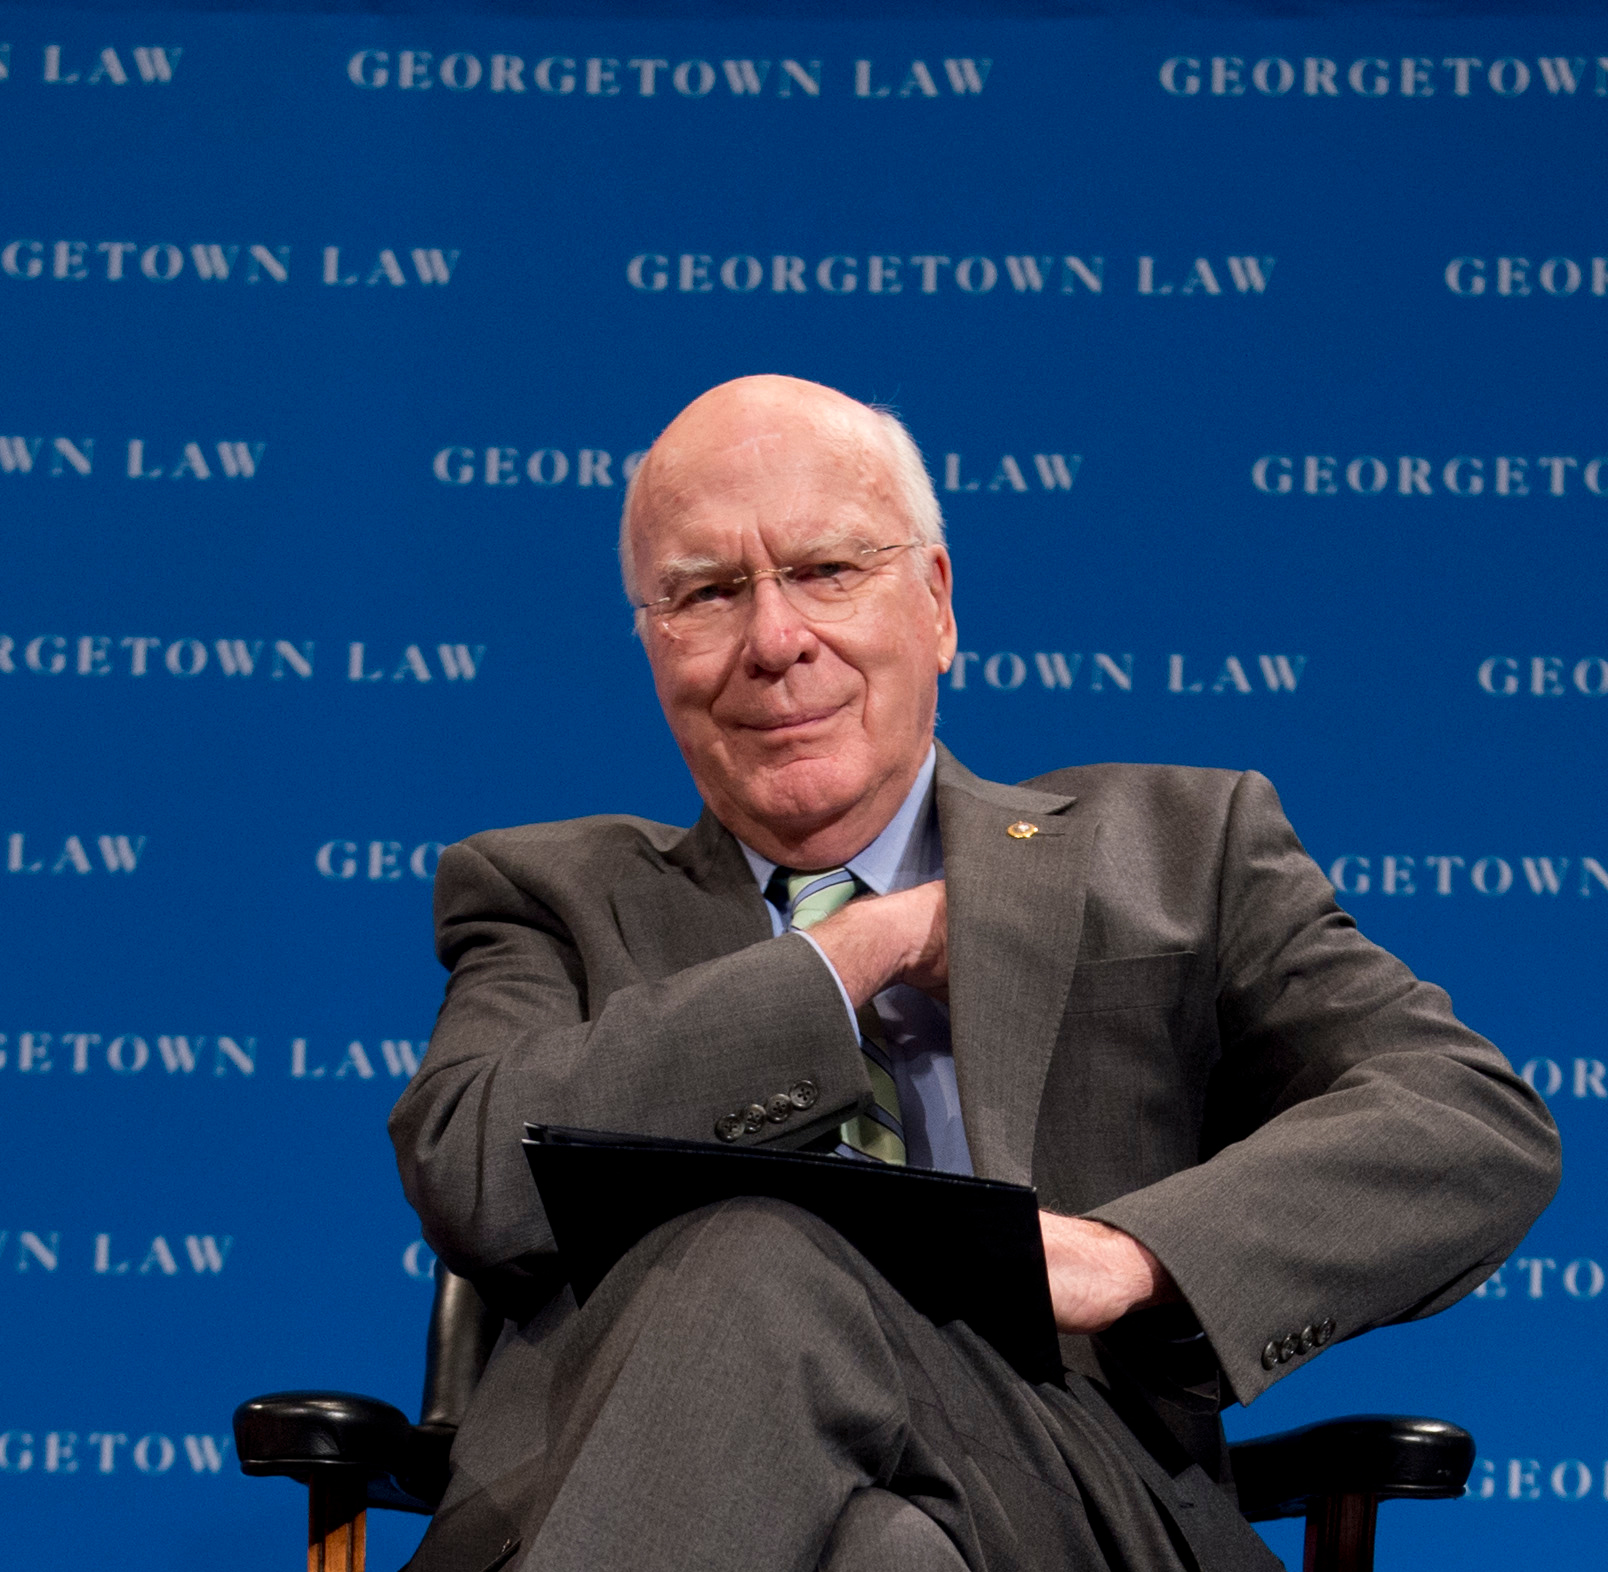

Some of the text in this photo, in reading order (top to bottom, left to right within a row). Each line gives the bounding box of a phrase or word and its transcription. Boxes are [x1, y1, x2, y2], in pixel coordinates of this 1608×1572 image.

[44, 44, 189, 85] LAW
[347, 50, 991, 97] GEORGETOWN LAW
[323, 246, 466, 286] LAW
[627, 254, 1274, 295] GEORGETOWN LAW
[127, 439, 264, 480] LAW
[944, 452, 1081, 492] LAW
[348, 642, 484, 683] LAW
[1168, 654, 1305, 694] LAW
[7, 833, 152, 874] LAW
[94, 1233, 231, 1275] LAW
